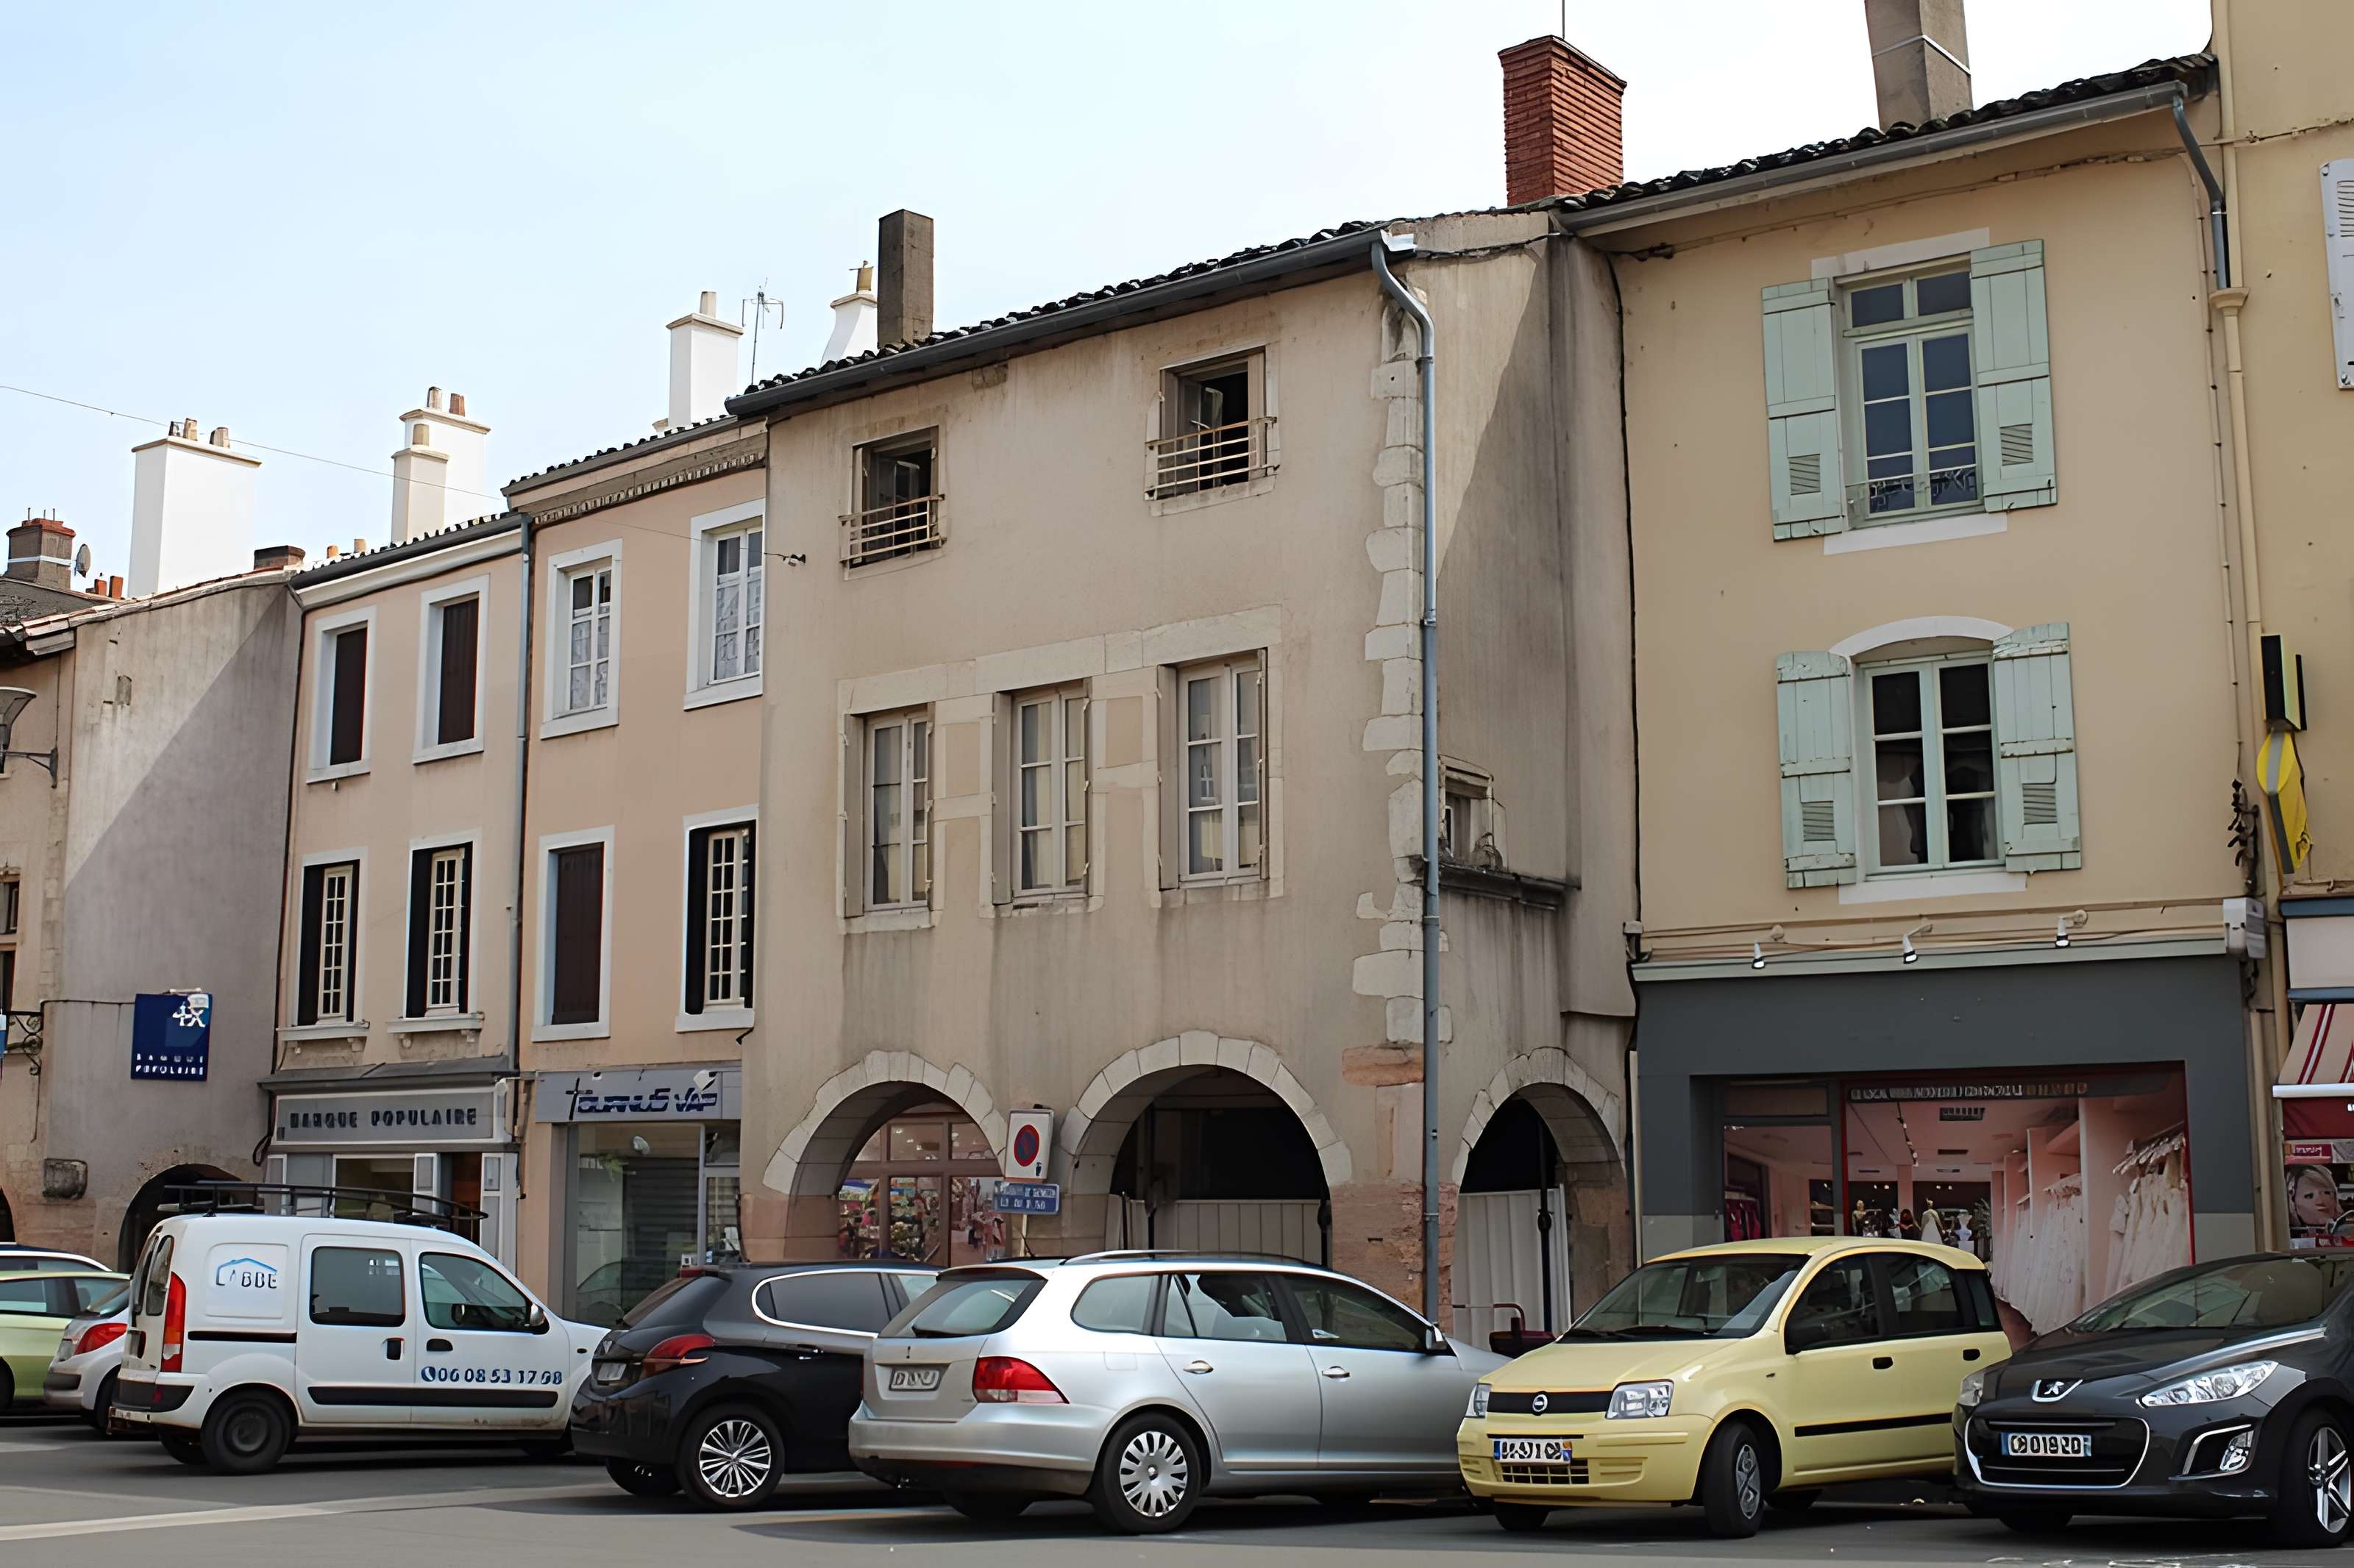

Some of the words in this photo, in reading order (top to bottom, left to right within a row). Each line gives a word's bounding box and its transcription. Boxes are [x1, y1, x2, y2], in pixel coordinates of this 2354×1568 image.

[371, 1108, 477, 1127] POPULAIRE
[438, 1367, 460, 1383] 06
[464, 1368, 486, 1383] 08
[518, 1370, 538, 1384] 17
